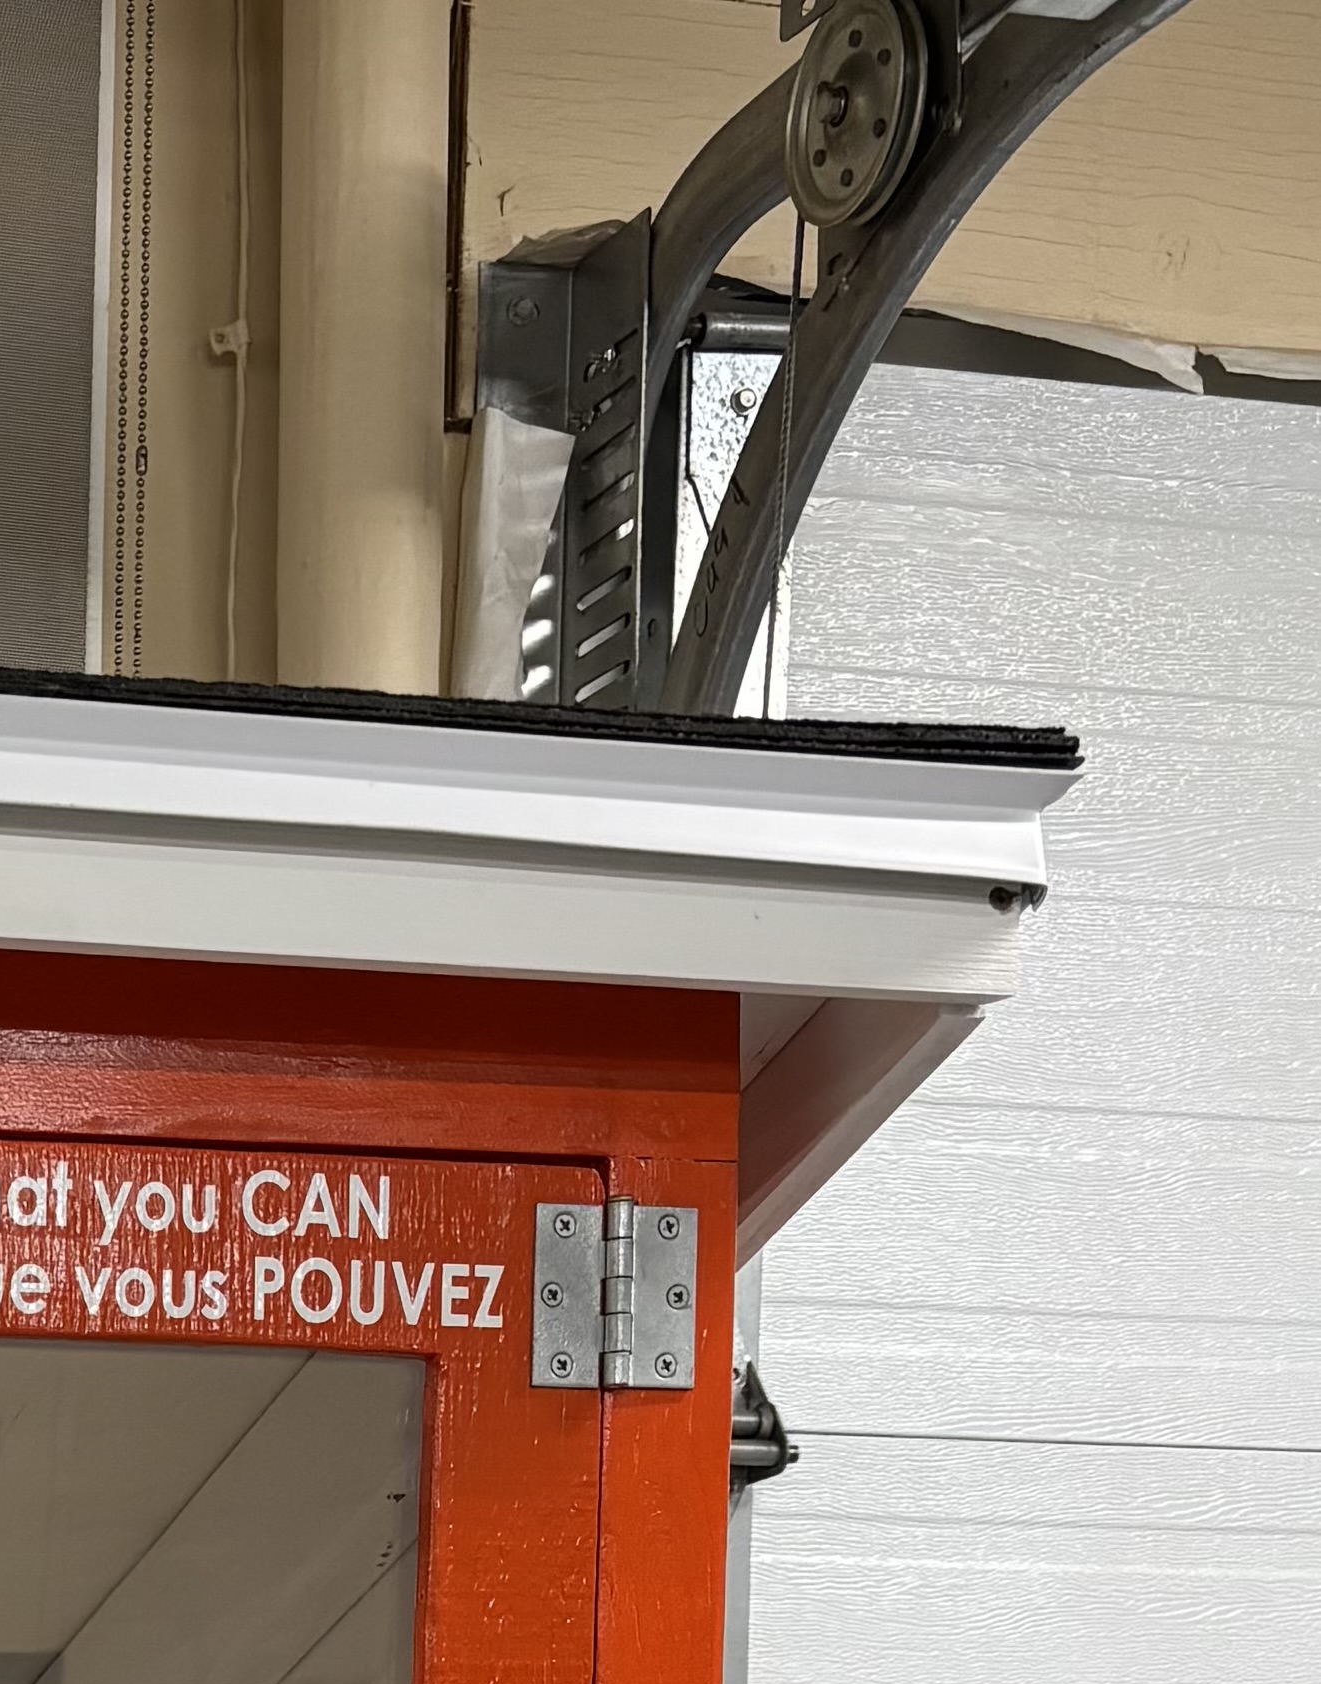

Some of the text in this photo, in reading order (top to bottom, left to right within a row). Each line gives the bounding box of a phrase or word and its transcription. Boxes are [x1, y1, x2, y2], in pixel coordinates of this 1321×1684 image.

[93, 1178, 220, 1246] you
[242, 1169, 390, 1240] CAN
[74, 1265, 230, 1320] vous
[254, 1254, 506, 1329] POUVEZ
